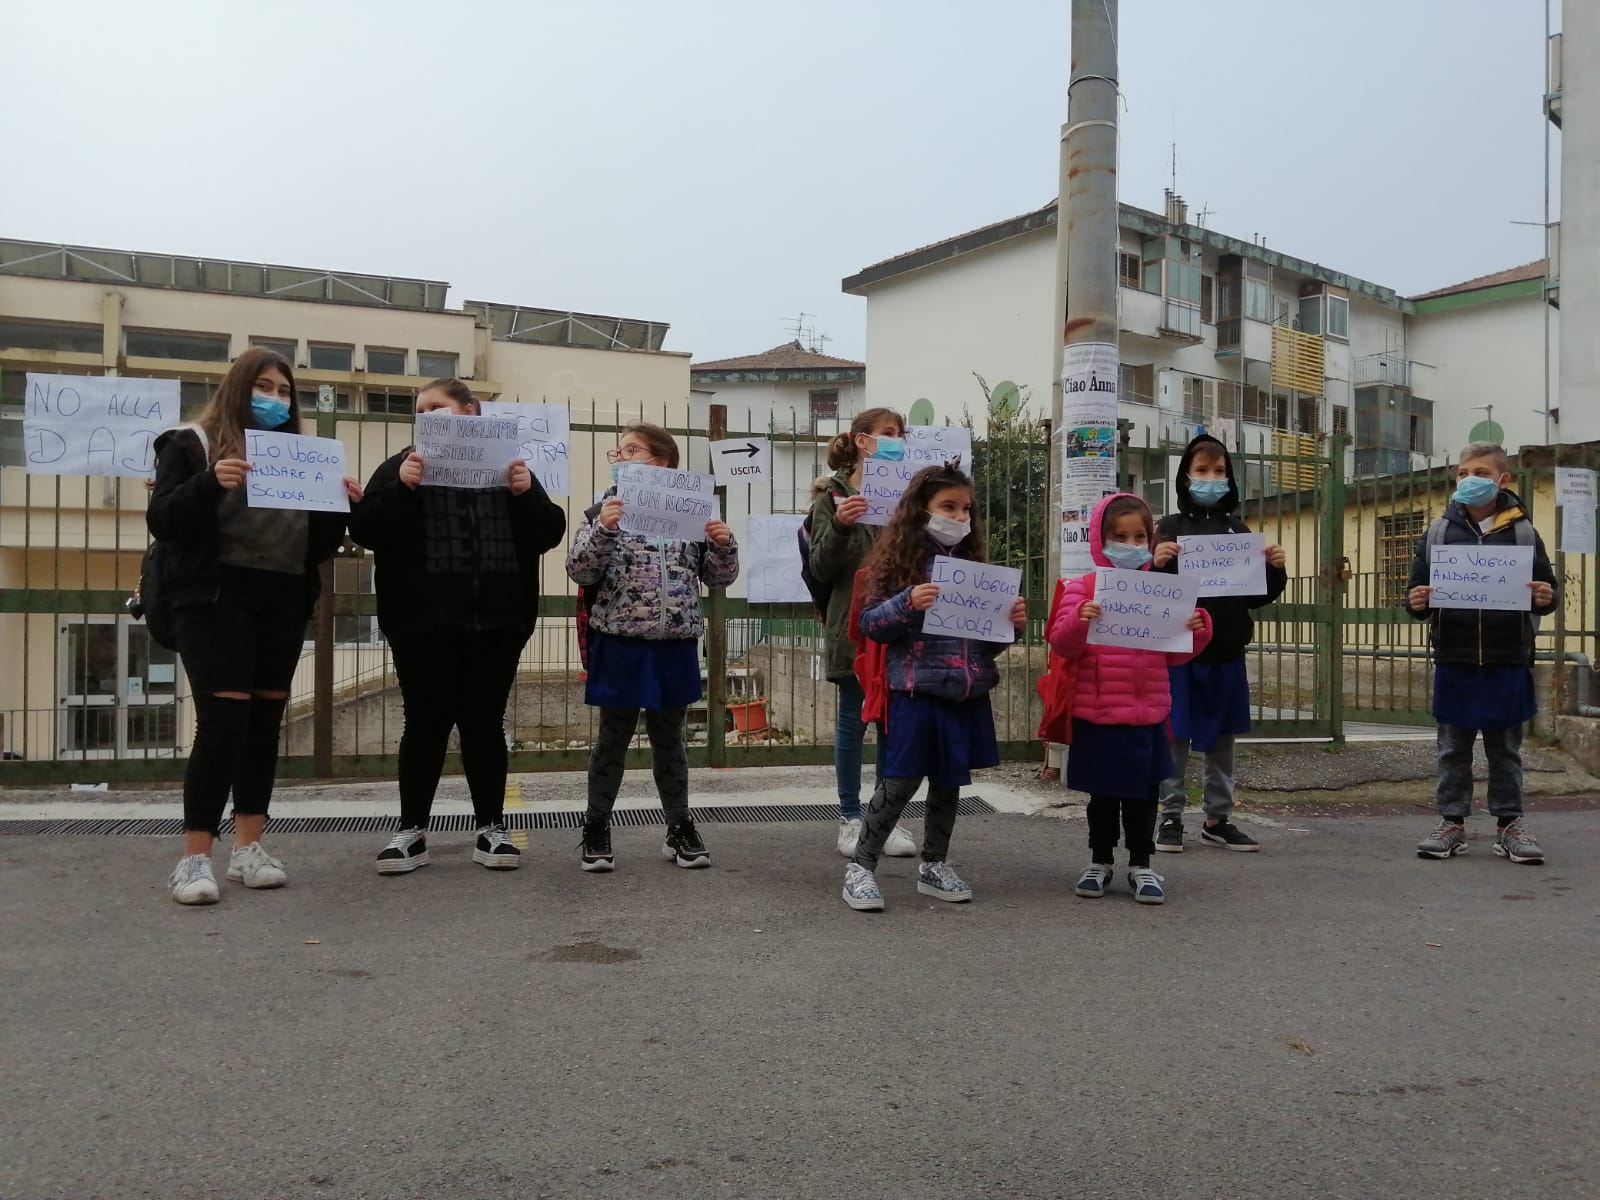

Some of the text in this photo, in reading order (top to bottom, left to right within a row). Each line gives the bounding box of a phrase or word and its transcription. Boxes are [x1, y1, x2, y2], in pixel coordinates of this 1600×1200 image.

[1065, 376, 1116, 394] Ciao Anna
[34, 382, 162, 421] NO ALLA
[420, 417, 518, 441] NON VOGLIAMO
[287, 440, 340, 464] VOGLIO
[421, 440, 485, 462] RESTARE
[251, 462, 324, 483] ANDARE A
[621, 464, 701, 492] LA SCUOLA
[730, 465, 762, 476] USCITA
[638, 488, 661, 509] UN
[665, 494, 713, 517] NOSTRO
[621, 511, 678, 534] DIRITTO
[1063, 527, 1078, 543] Ciao
[1211, 540, 1251, 552] VOGLIO
[1184, 556, 1250, 570] ANDARE A
[1466, 551, 1517, 568] VOGLIO
[973, 571, 1017, 596] VOGLIO
[1433, 568, 1506, 585] ANDARE A
[1134, 580, 1183, 600] VOGLIO
[993, 603, 1003, 614] A
[1101, 598, 1170, 620] ANDARE A
